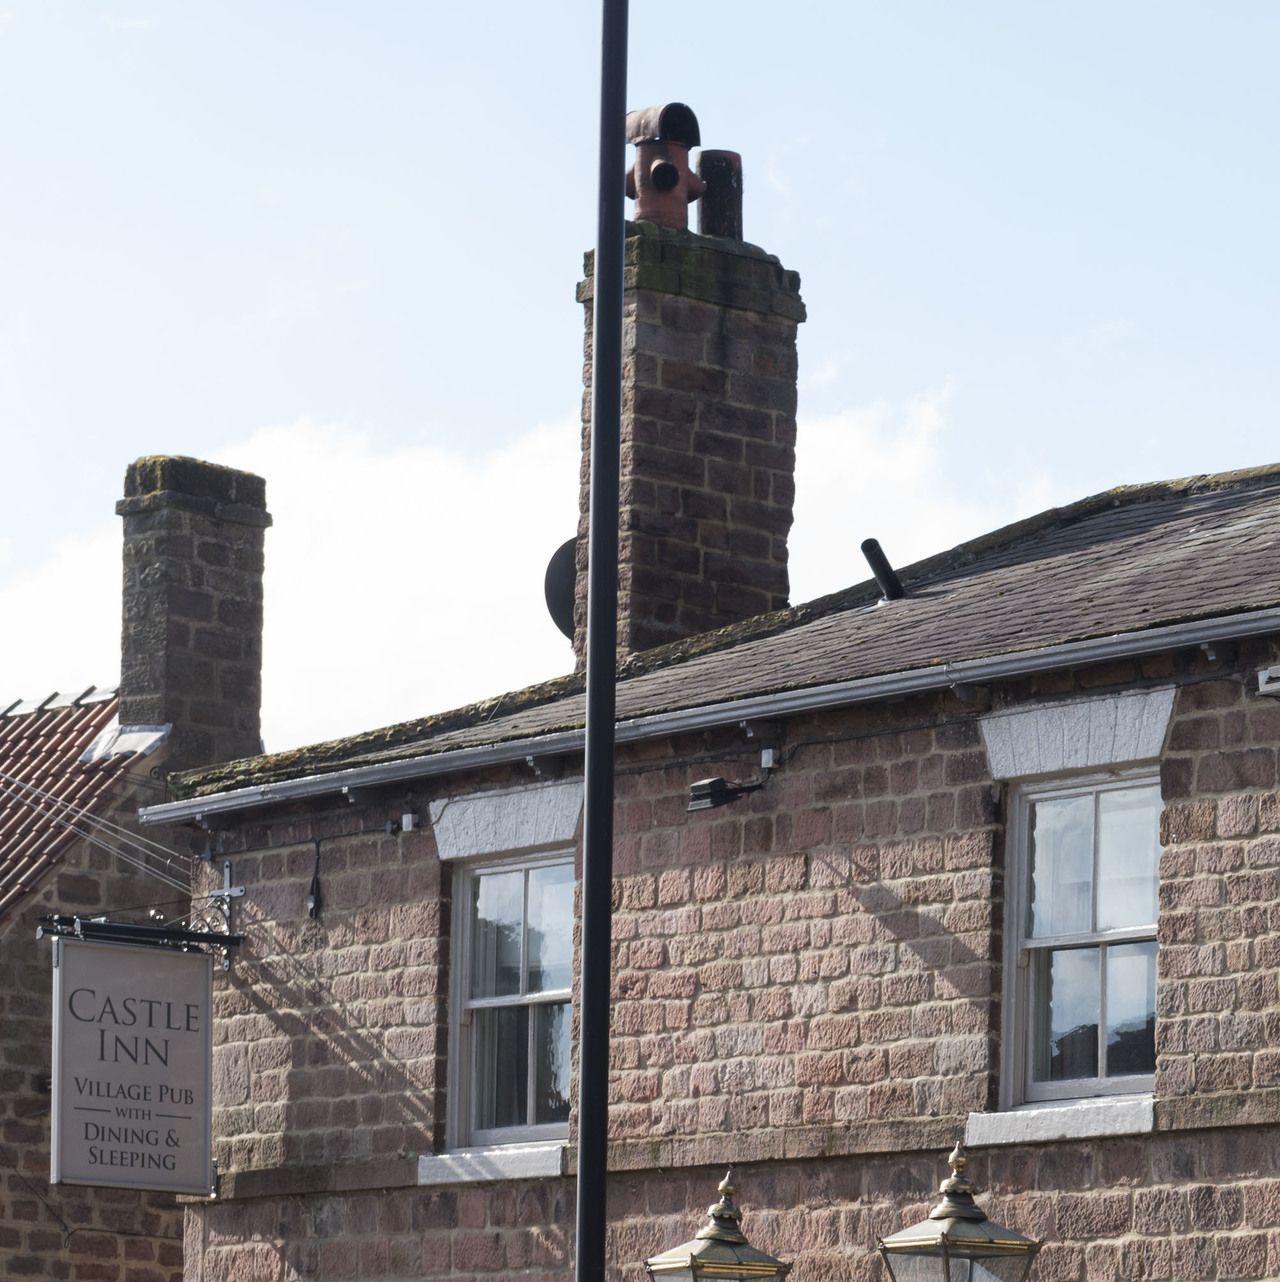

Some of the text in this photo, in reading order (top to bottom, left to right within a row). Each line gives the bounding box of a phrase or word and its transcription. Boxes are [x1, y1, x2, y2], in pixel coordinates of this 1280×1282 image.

[69, 988, 200, 1031] CASTLE
[98, 1029, 169, 1066] INN
[74, 1077, 194, 1105] VILLAGE PUB
[115, 1108, 152, 1121] WITH
[84, 1122, 181, 1148] DINING &
[88, 1146, 176, 1171] SLEEPING
